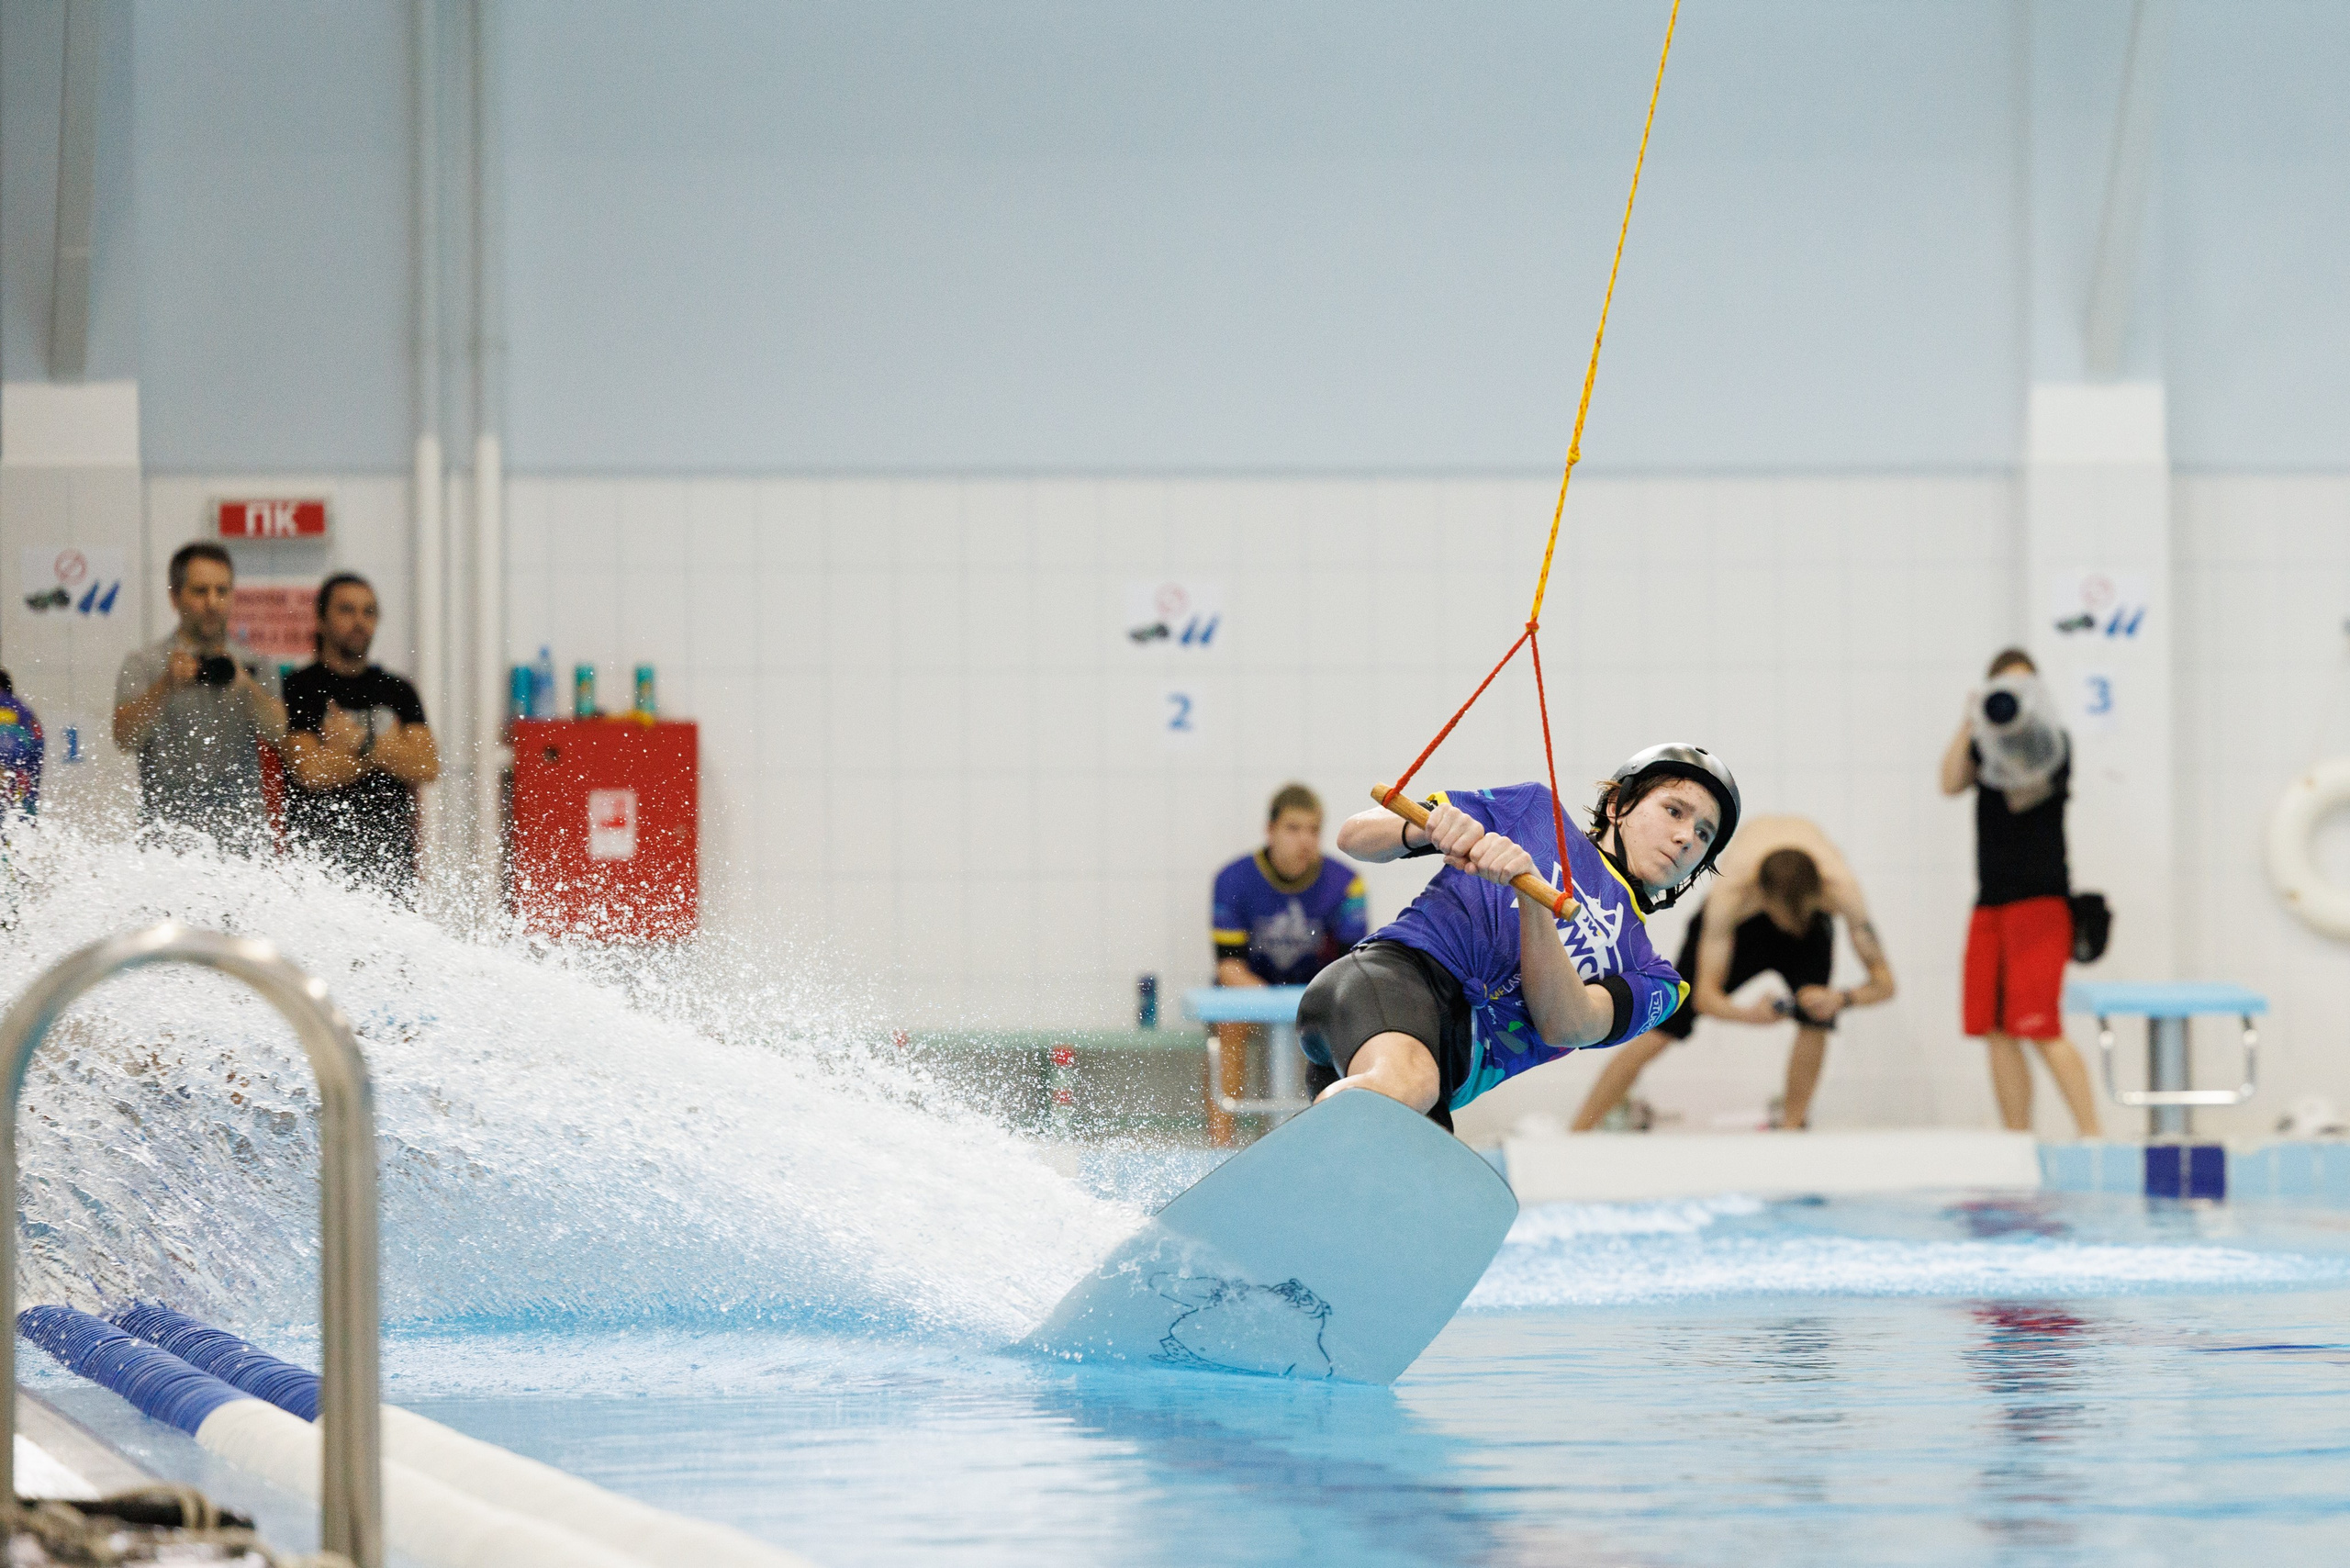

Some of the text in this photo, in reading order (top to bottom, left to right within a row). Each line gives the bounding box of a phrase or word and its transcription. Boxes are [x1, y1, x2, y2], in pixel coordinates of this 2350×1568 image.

[246, 502, 298, 538] ПК
[1167, 692, 1193, 732] 2
[2085, 675, 2112, 714] 3
[62, 725, 84, 764] 1
